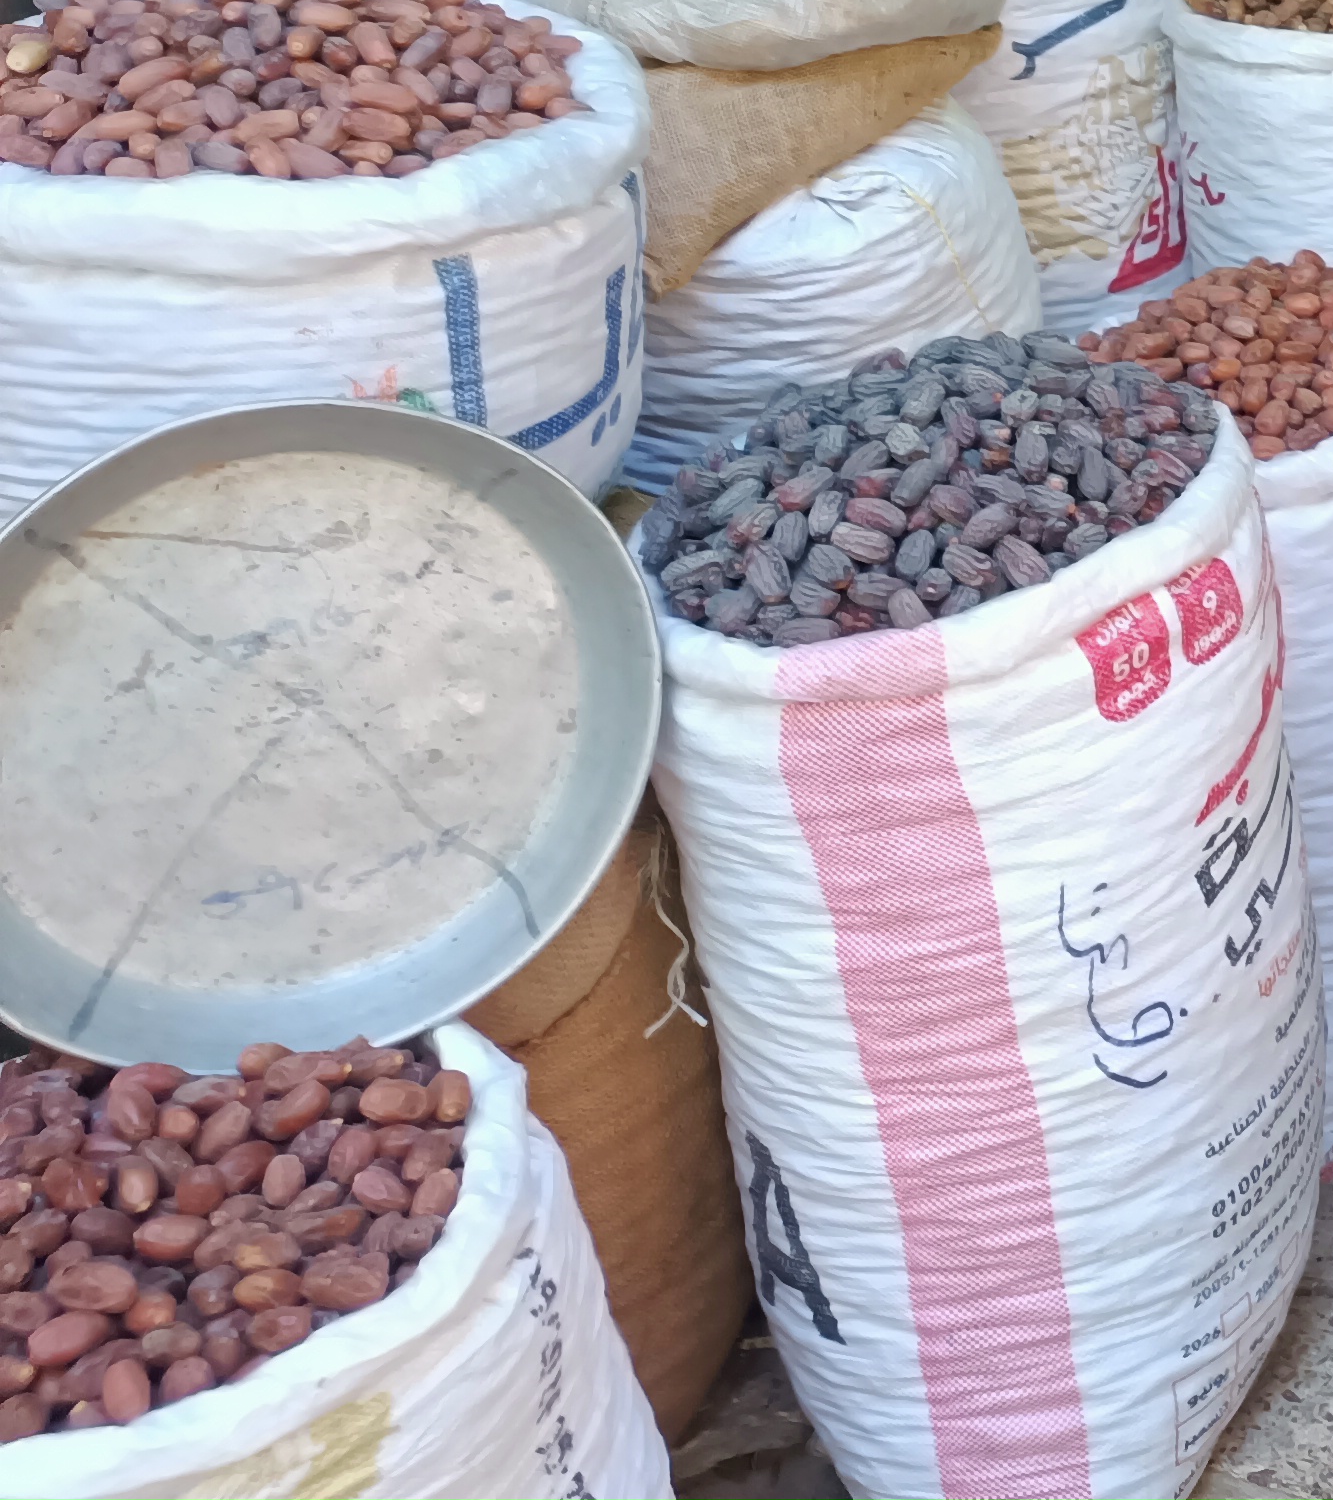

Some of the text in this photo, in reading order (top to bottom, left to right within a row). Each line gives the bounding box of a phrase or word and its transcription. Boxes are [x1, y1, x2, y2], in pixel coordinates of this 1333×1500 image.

[1095, 605, 1141, 648] الوزن
[1112, 643, 1151, 682] 50
[745, 1129, 848, 1346] A
[1180, 1326, 1222, 1359] 2026
